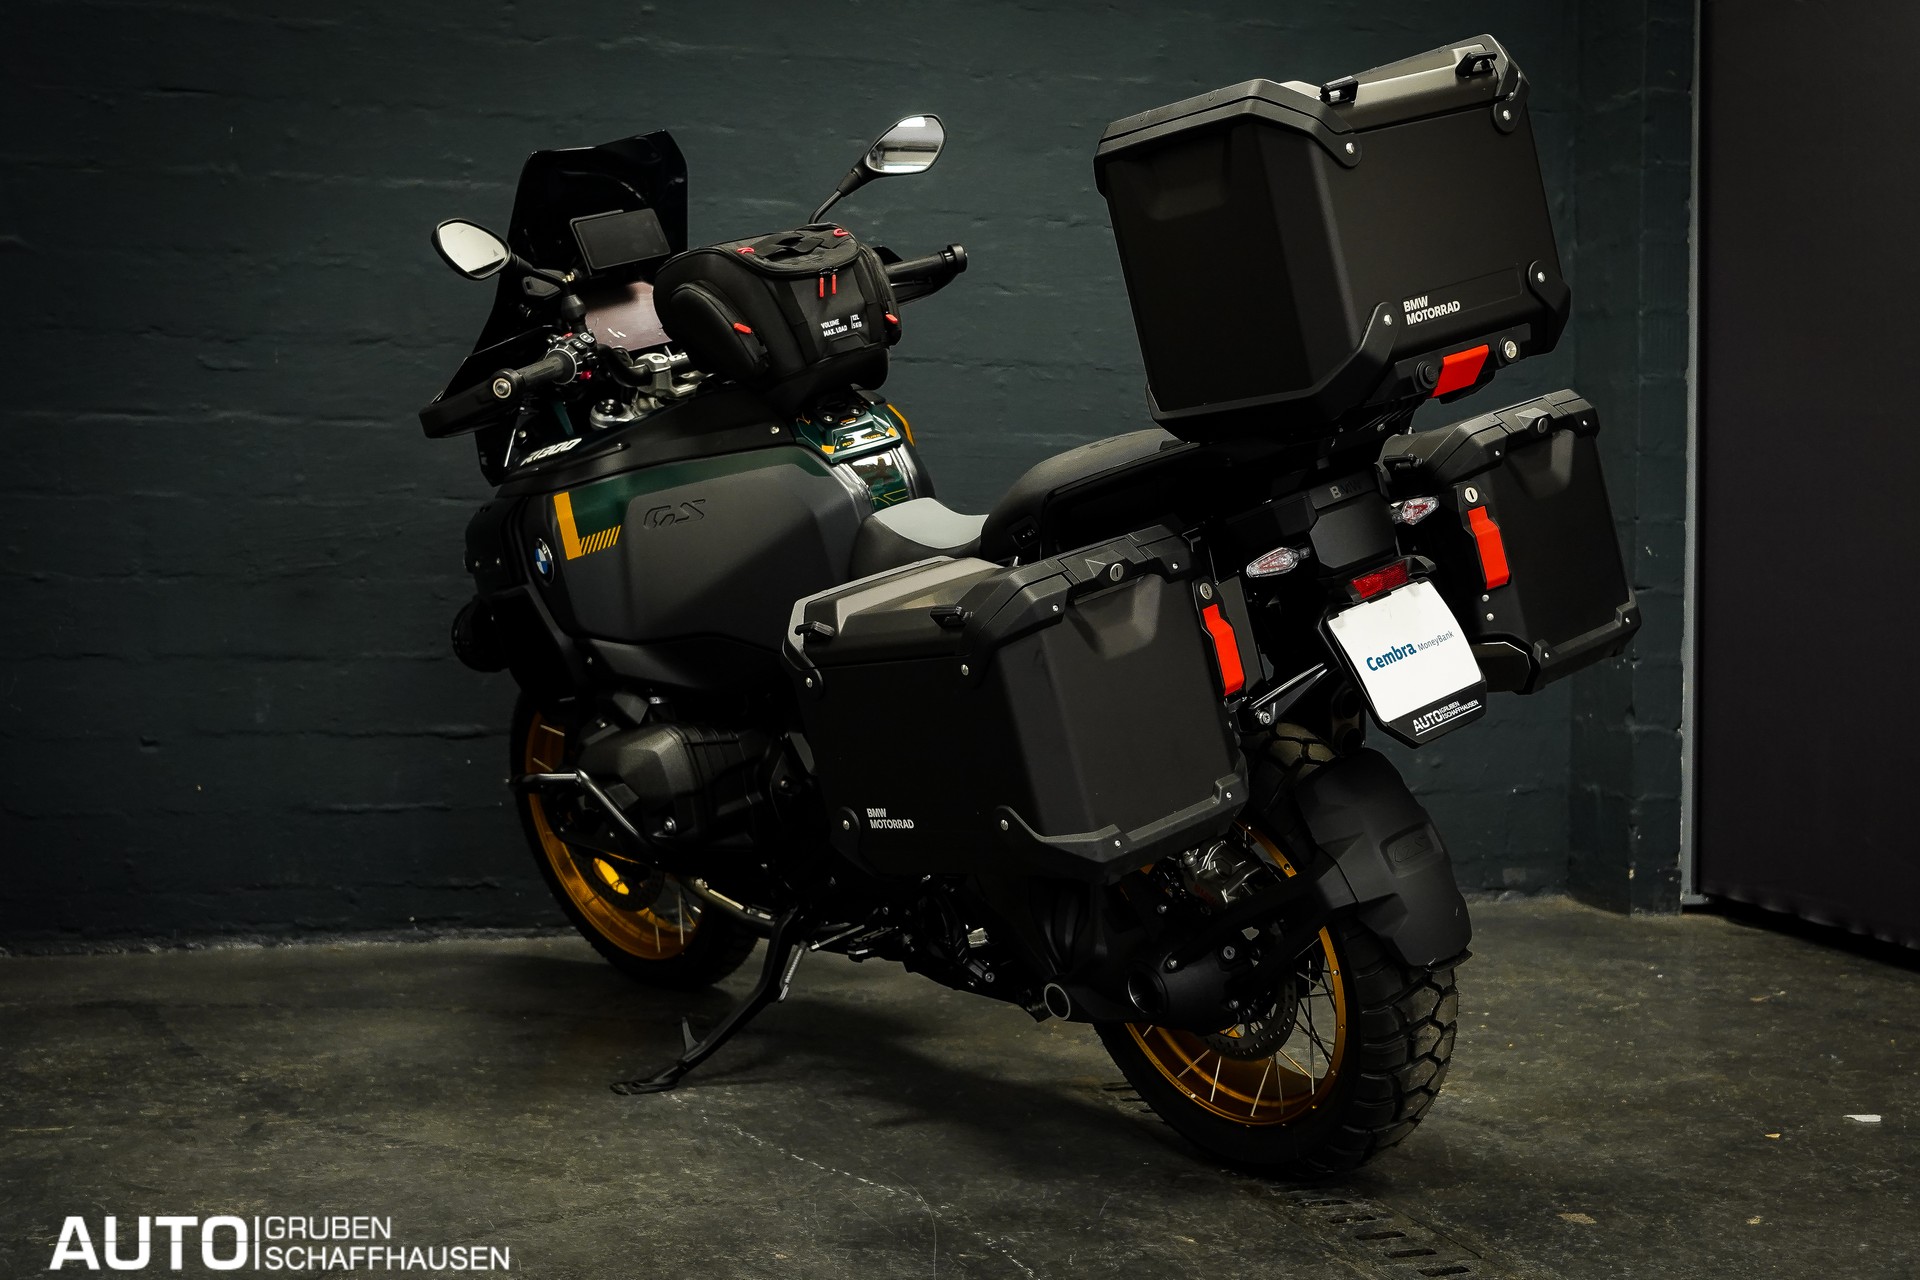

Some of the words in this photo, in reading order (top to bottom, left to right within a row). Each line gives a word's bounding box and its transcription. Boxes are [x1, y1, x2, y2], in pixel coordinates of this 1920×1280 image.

[1403, 295, 1428, 313] BMW
[1406, 300, 1461, 326] MOTORRAD
[820, 318, 841, 330] VOLUME
[1366, 643, 1417, 672] Cembra
[1417, 630, 1455, 652] MoneyBank
[1412, 709, 1444, 733] AUTO
[866, 807, 887, 818] BMW
[869, 818, 915, 830] MOTORRAD
